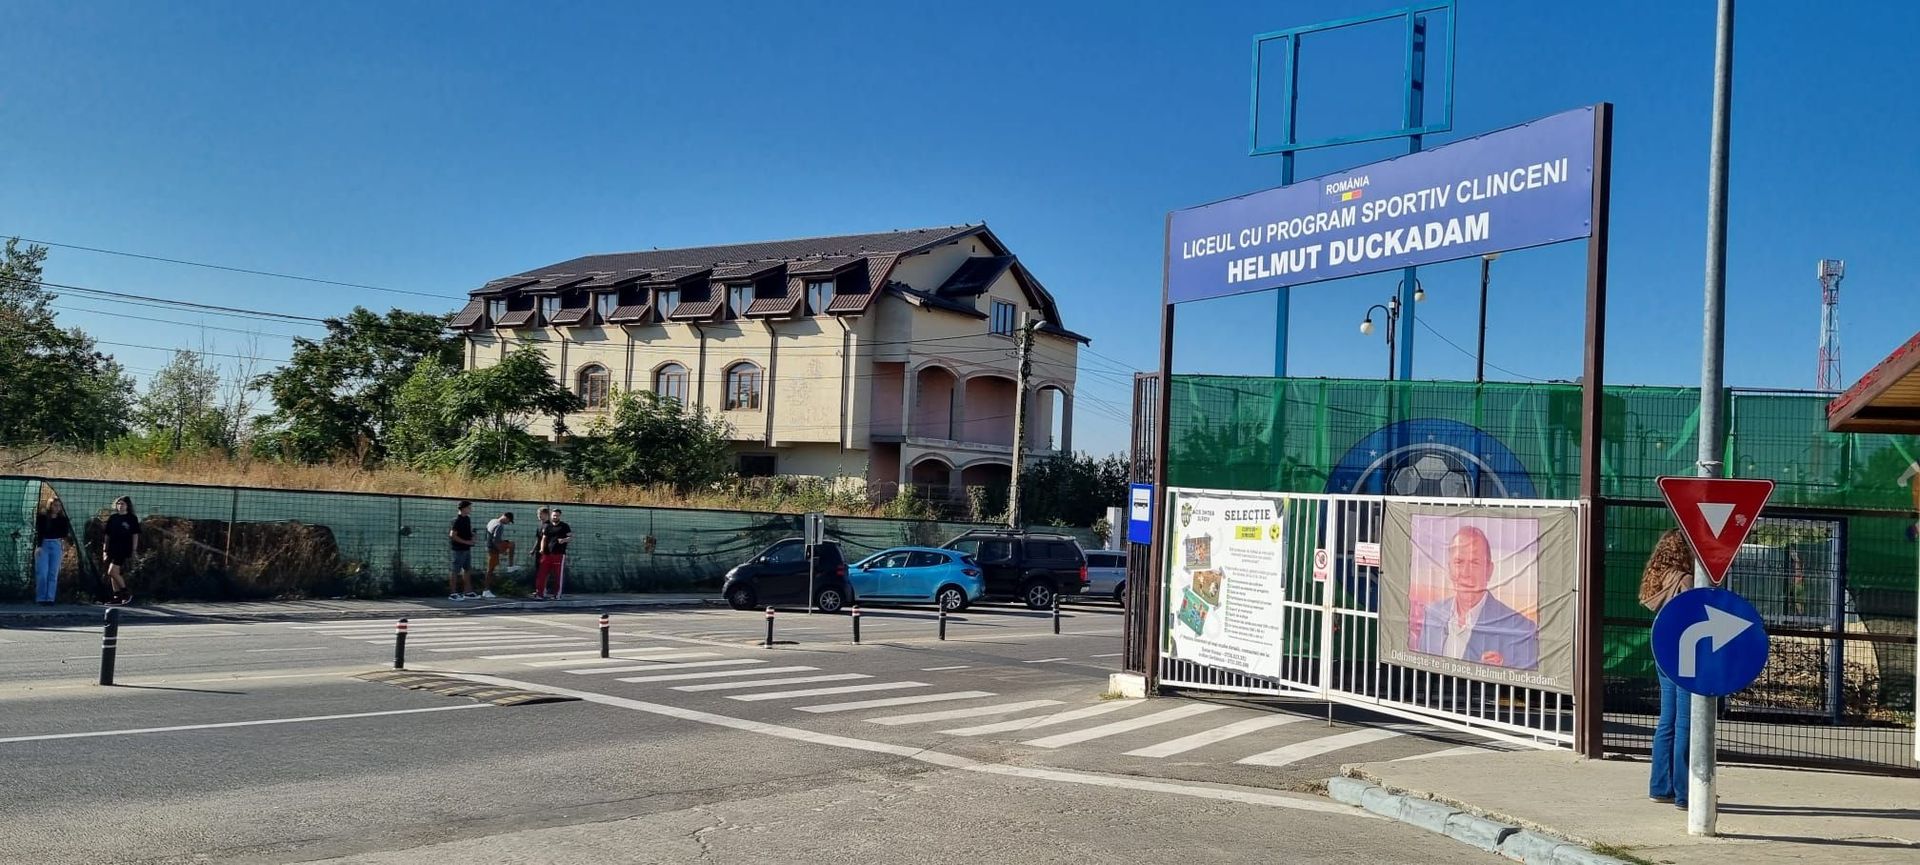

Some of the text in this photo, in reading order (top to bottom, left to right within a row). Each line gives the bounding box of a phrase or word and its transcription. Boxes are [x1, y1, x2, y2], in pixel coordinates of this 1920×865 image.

[1183, 157, 1568, 260] LICEUL CU PROGRAM SPORTIV CLINCENI
[1228, 211, 1490, 284] HELMUT DUCKADAM
[1451, 663, 1473, 676] pace,
[1475, 665, 1506, 681] Helmut
[1508, 670, 1559, 687] Duckadam!
